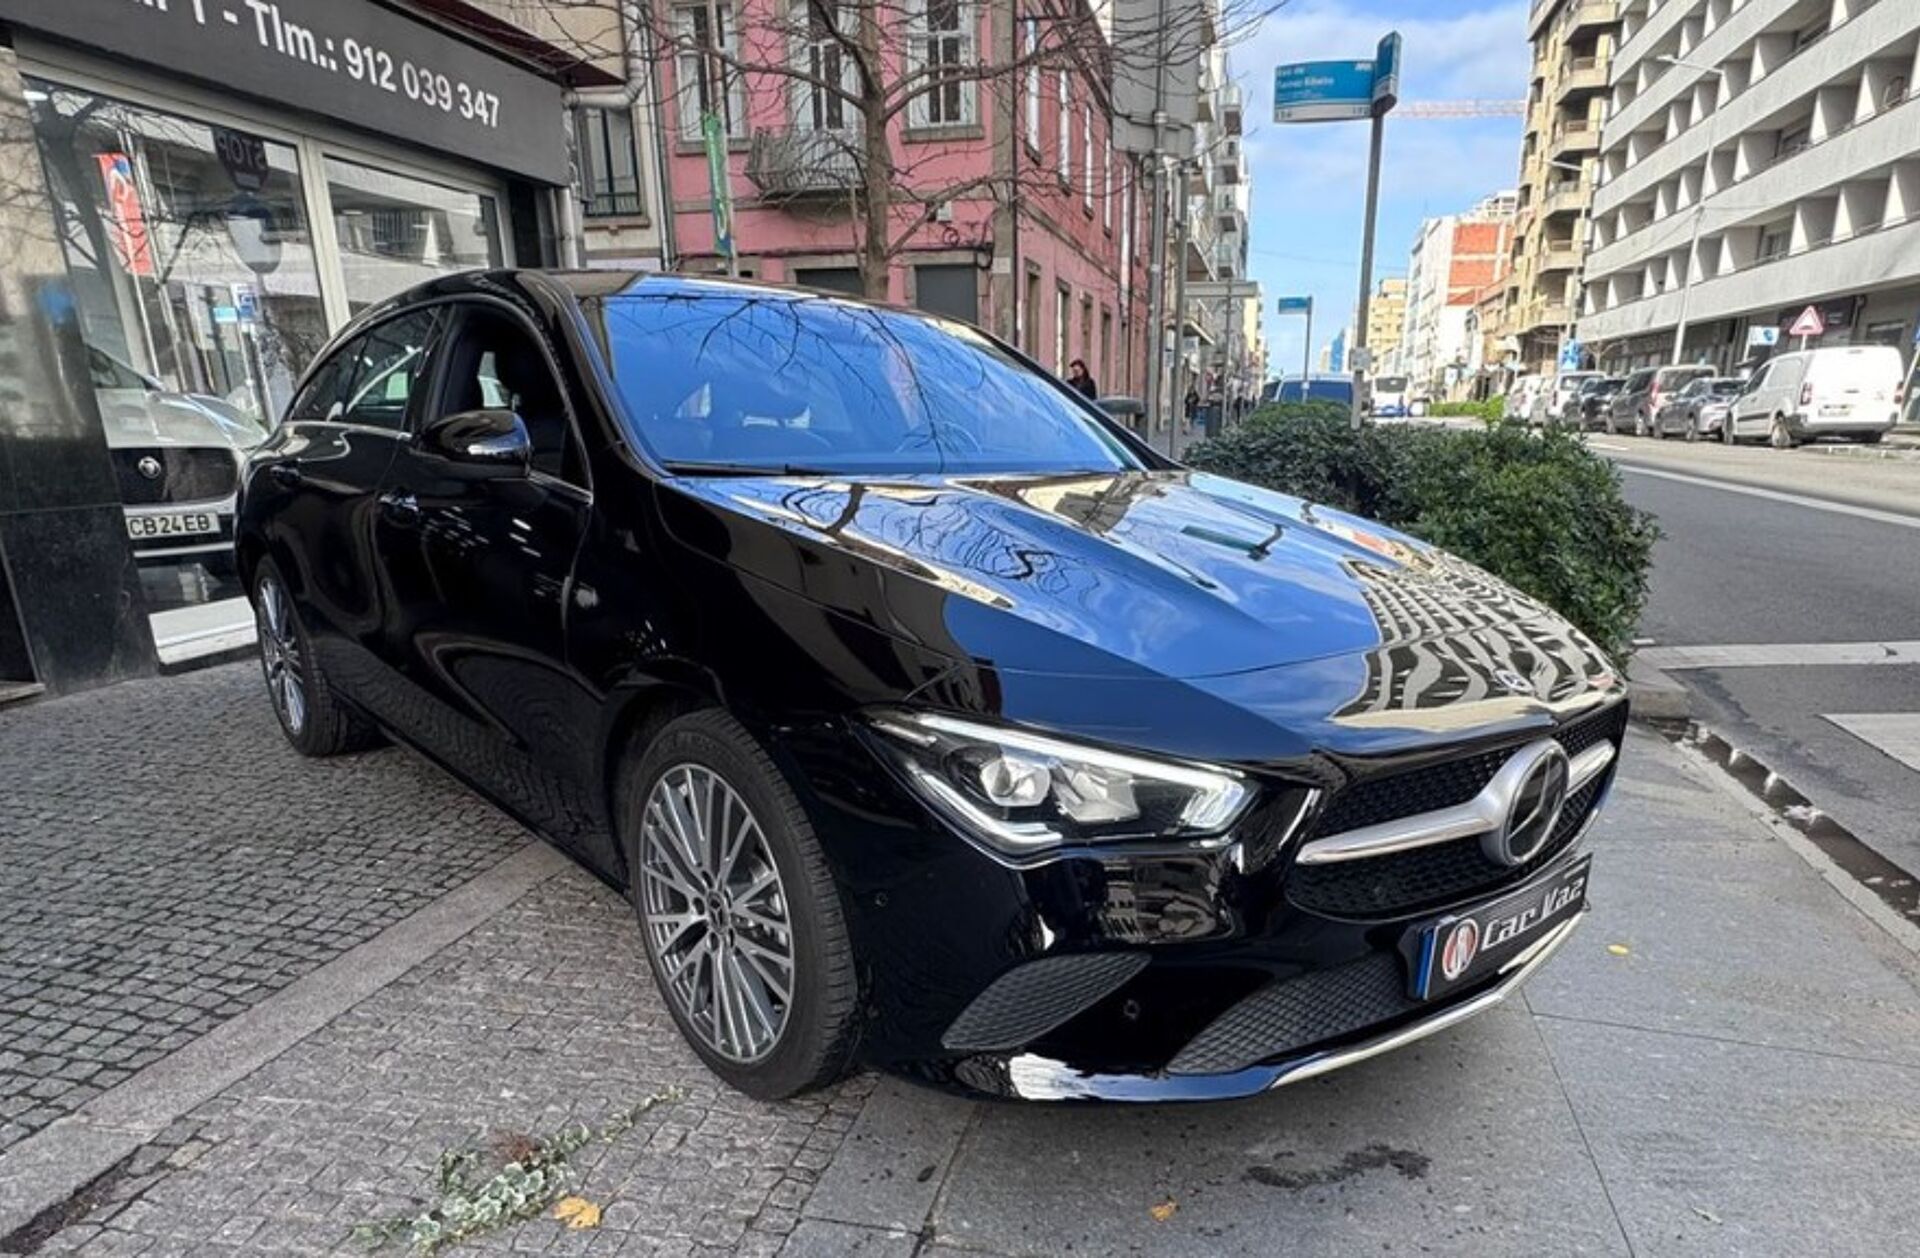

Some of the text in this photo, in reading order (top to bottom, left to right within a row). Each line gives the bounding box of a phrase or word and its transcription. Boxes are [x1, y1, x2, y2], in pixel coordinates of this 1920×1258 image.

[245, 0, 337, 71] Tlm.:
[343, 38, 397, 93] 912
[402, 61, 452, 113] 039
[457, 82, 500, 128] 347
[1482, 908, 1536, 951] Car
[1541, 876, 1586, 920] Vaz
